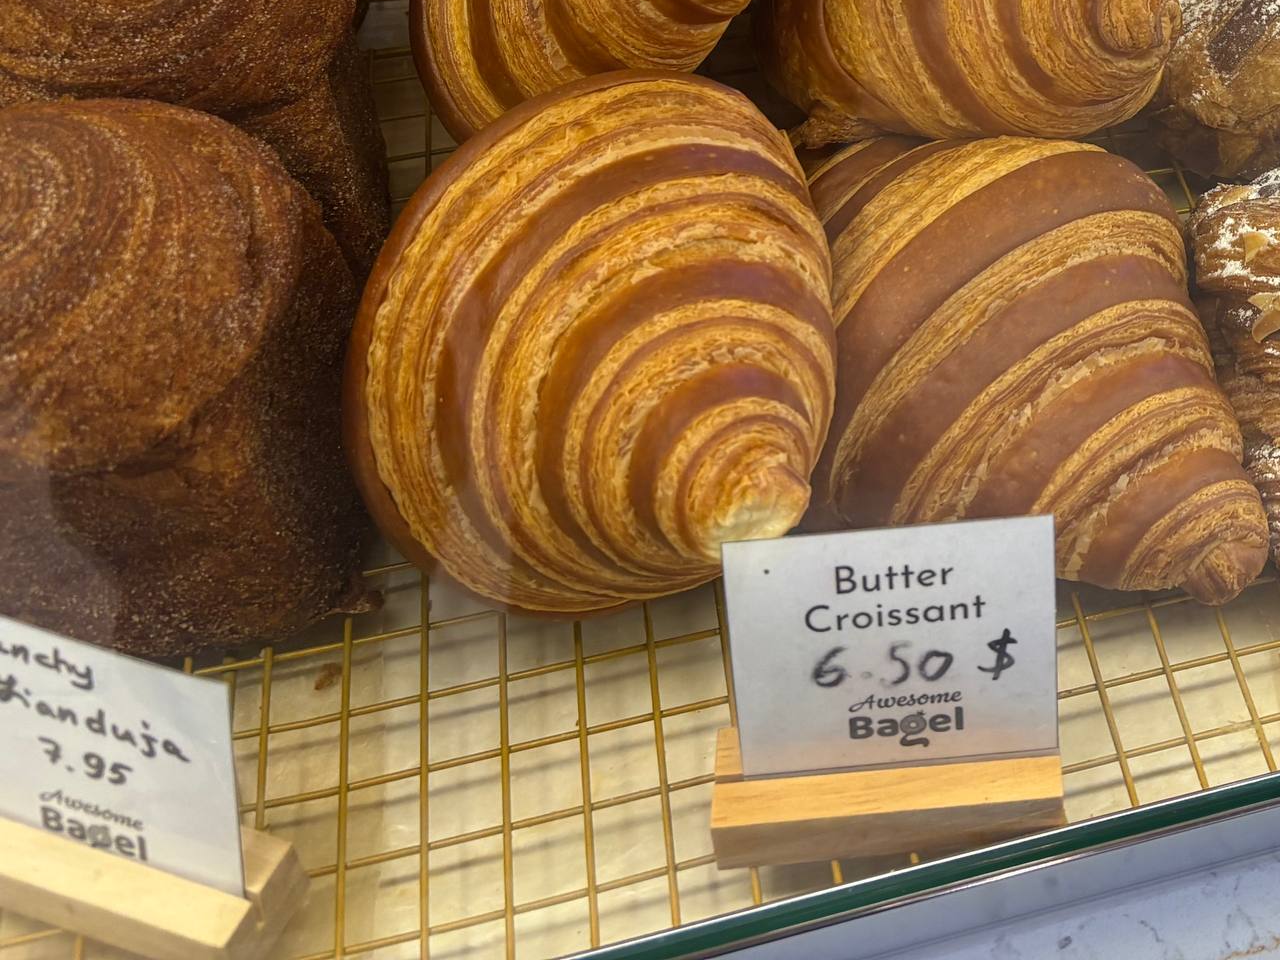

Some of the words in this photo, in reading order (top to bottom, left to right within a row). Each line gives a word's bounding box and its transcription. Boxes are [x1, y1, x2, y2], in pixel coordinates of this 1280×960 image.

[834, 564, 954, 595] Butter
[804, 595, 986, 633] Croissant
[0, 641, 95, 690] nchy
[812, 640, 954, 688] 6.50
[977, 628, 1018, 680] $
[848, 691, 962, 713] Awesome
[848, 707, 964, 748] Bagel
[38, 737, 133, 785] 7.95
[39, 789, 144, 831] Awesome
[41, 806, 148, 861] Bagel
